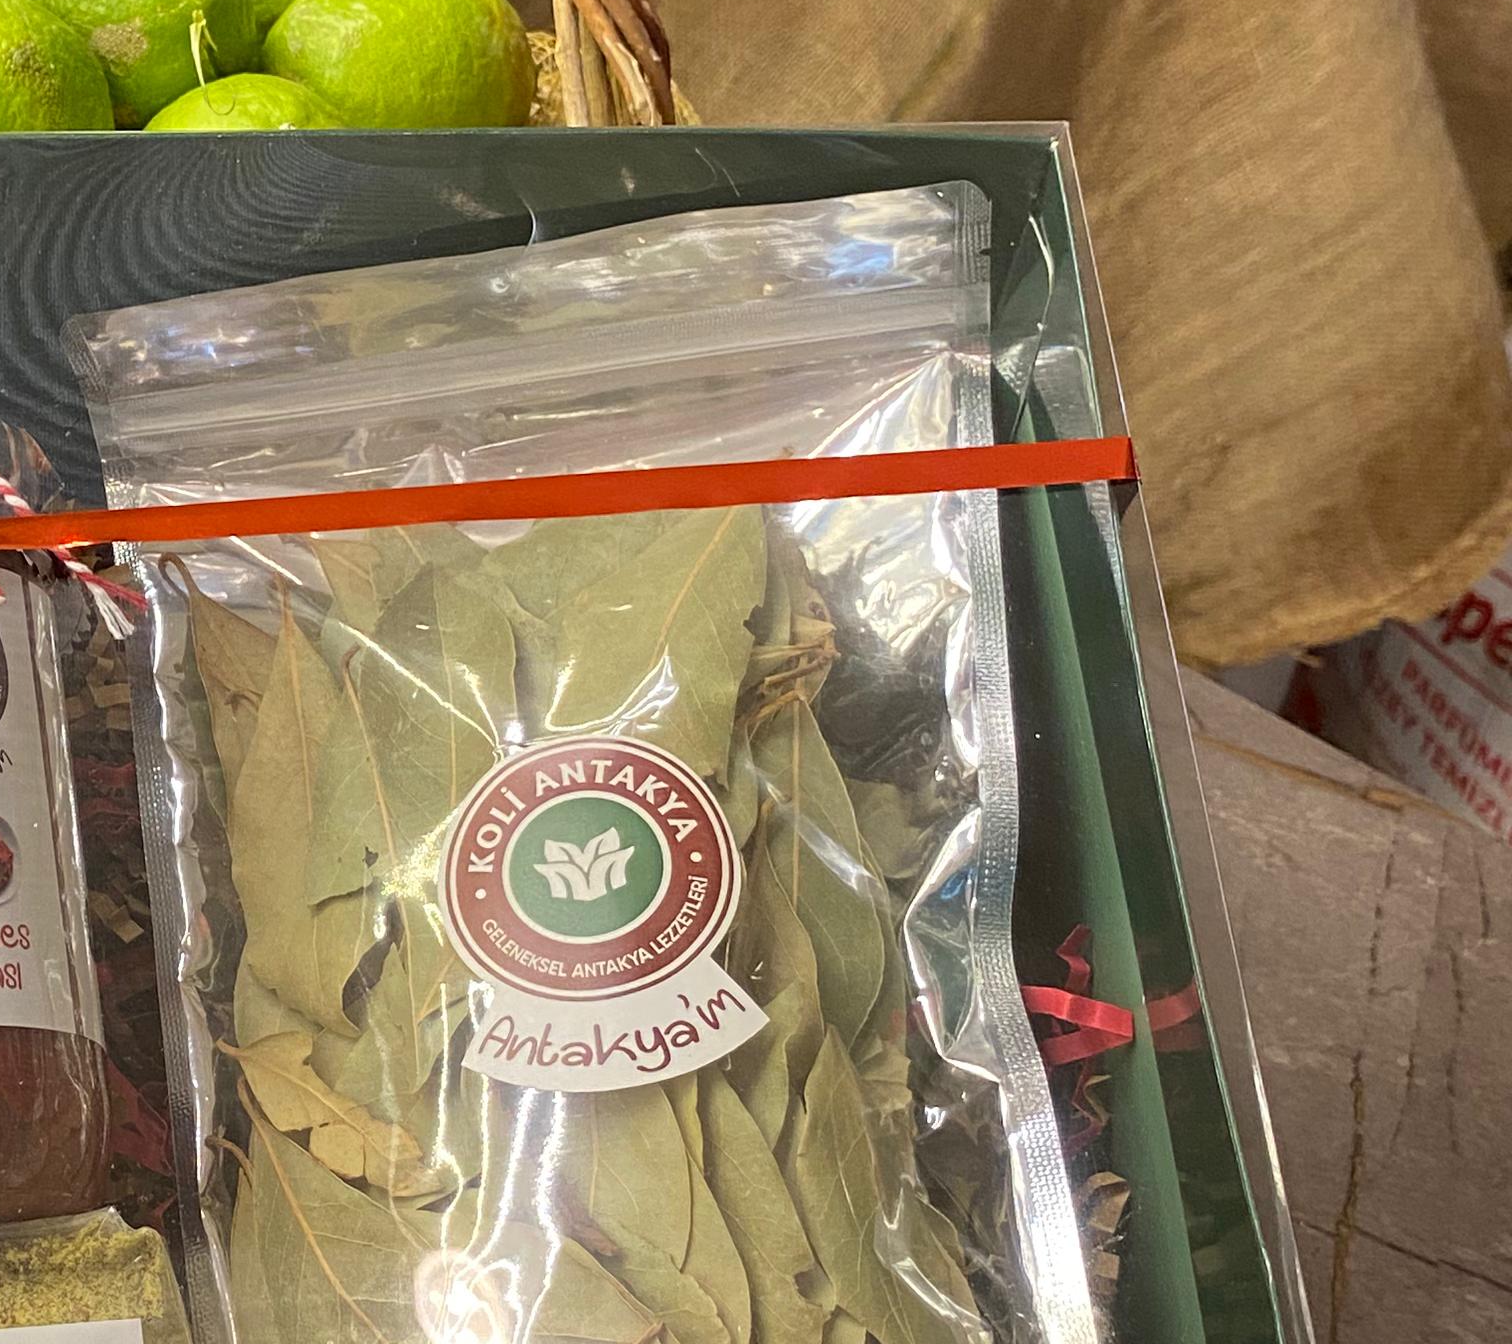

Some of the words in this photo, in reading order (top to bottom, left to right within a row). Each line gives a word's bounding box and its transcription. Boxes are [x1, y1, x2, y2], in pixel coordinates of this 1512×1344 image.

[467, 787, 526, 874] KOLİ
[534, 759, 699, 843] ANTAKYA
[481, 918, 568, 979] GELENEKSEL
[571, 949, 655, 979] ANTAKYA
[652, 875, 709, 955] LEZZETLERİ
[478, 987, 747, 1073] Antakya'm
